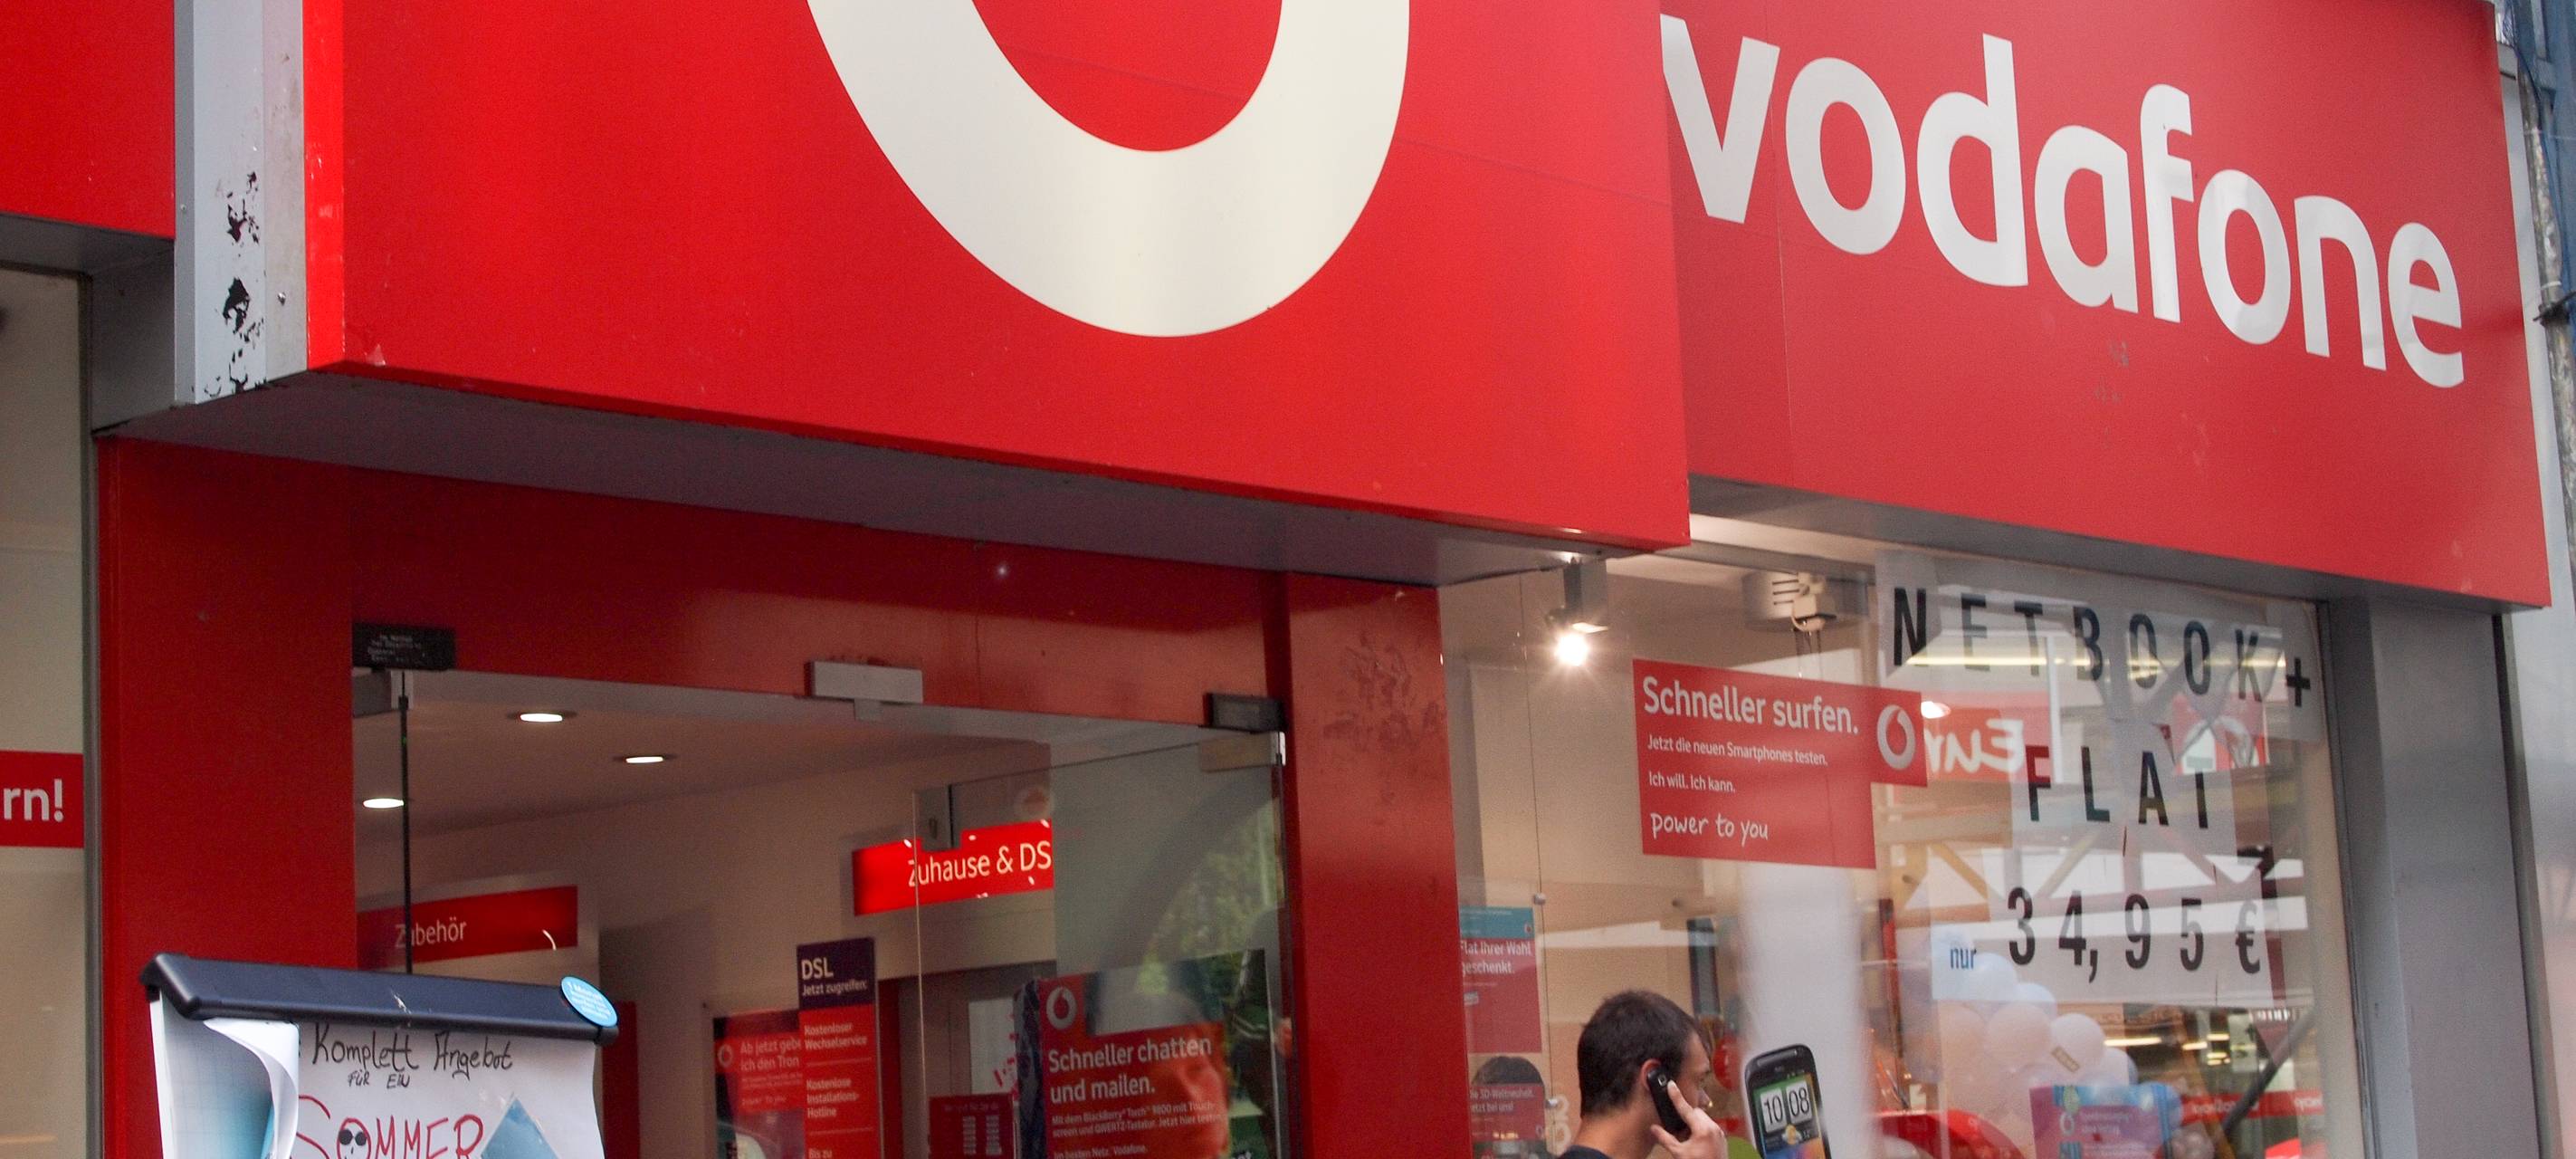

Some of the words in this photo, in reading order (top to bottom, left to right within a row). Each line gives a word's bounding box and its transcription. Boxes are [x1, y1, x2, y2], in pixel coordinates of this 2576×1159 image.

[1660, 14, 2464, 388] vodafone
[1643, 675, 1766, 724] Schneller
[1772, 695, 1858, 734] surfen.
[1647, 734, 1674, 751] Jetzt
[1675, 737, 1691, 752] die
[1693, 742, 1724, 756] neuen
[1727, 742, 1793, 762] Smartphones
[1795, 751, 1827, 765] testen.
[1649, 771, 1665, 787] Ich
[1666, 772, 1689, 789] will.
[1691, 774, 1705, 790] Ich
[1708, 777, 1736, 793] kann.
[4, 779, 63, 822] rn!
[1650, 812, 1708, 839] power
[1715, 813, 1734, 838] to
[1741, 819, 1768, 847] you
[908, 856, 990, 887] Zuhause
[997, 846, 1013, 875] &
[1481, 942, 1503, 955] Ihrer
[1506, 942, 1531, 956] Wahl
[1950, 944, 1977, 970] nur
[2008, 887, 2204, 984] 34,95
[2235, 896, 2262, 974] €
[801, 957, 834, 980] DSL
[802, 983, 825, 997] Jetzt
[804, 1022, 853, 1036] Kostenloser
[312, 1023, 420, 1072] Komplett
[433, 1030, 514, 1081] Angebot
[740, 1042, 754, 1056] Ab
[755, 1039, 778, 1057] jetzt
[805, 1036, 867, 1051] Wechselservice
[1048, 1044, 1133, 1074] Schneller
[1138, 1037, 1212, 1062] chatten
[757, 1057, 776, 1071] den
[348, 1068, 370, 1087] FÜR
[386, 1072, 410, 1089] EIN
[806, 1077, 852, 1091] Kostenlose
[1051, 1076, 1085, 1104] und
[1091, 1073, 1156, 1100] mailen.
[807, 1106, 836, 1119] Hotline
[1764, 1095, 1783, 1125] 10
[1789, 1087, 1810, 1117] 08
